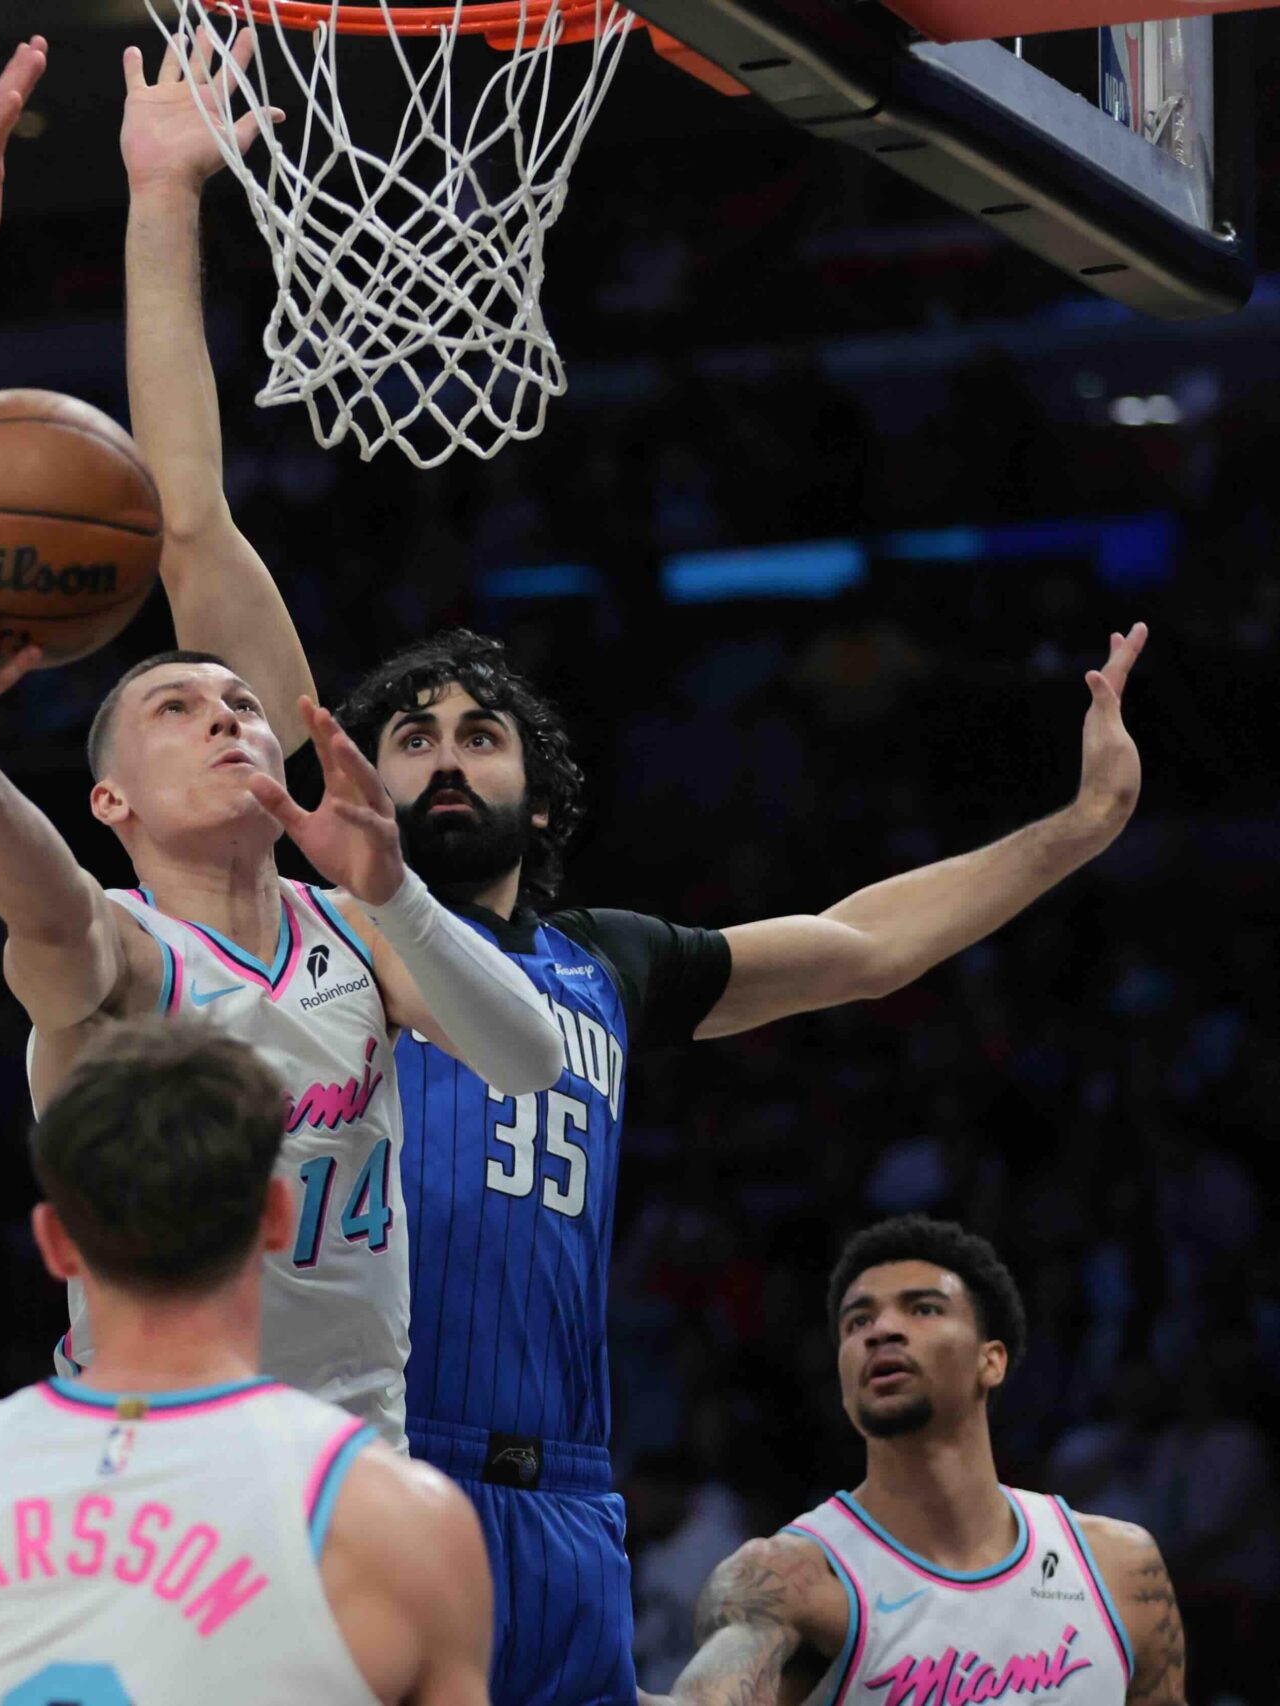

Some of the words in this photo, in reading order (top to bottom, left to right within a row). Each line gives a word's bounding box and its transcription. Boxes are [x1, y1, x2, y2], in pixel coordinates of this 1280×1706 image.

[300, 974, 370, 1011] Robinhood
[293, 1138, 393, 1268] 14
[487, 1084, 588, 1217] 35
[865, 1623, 1092, 1706] Miami
